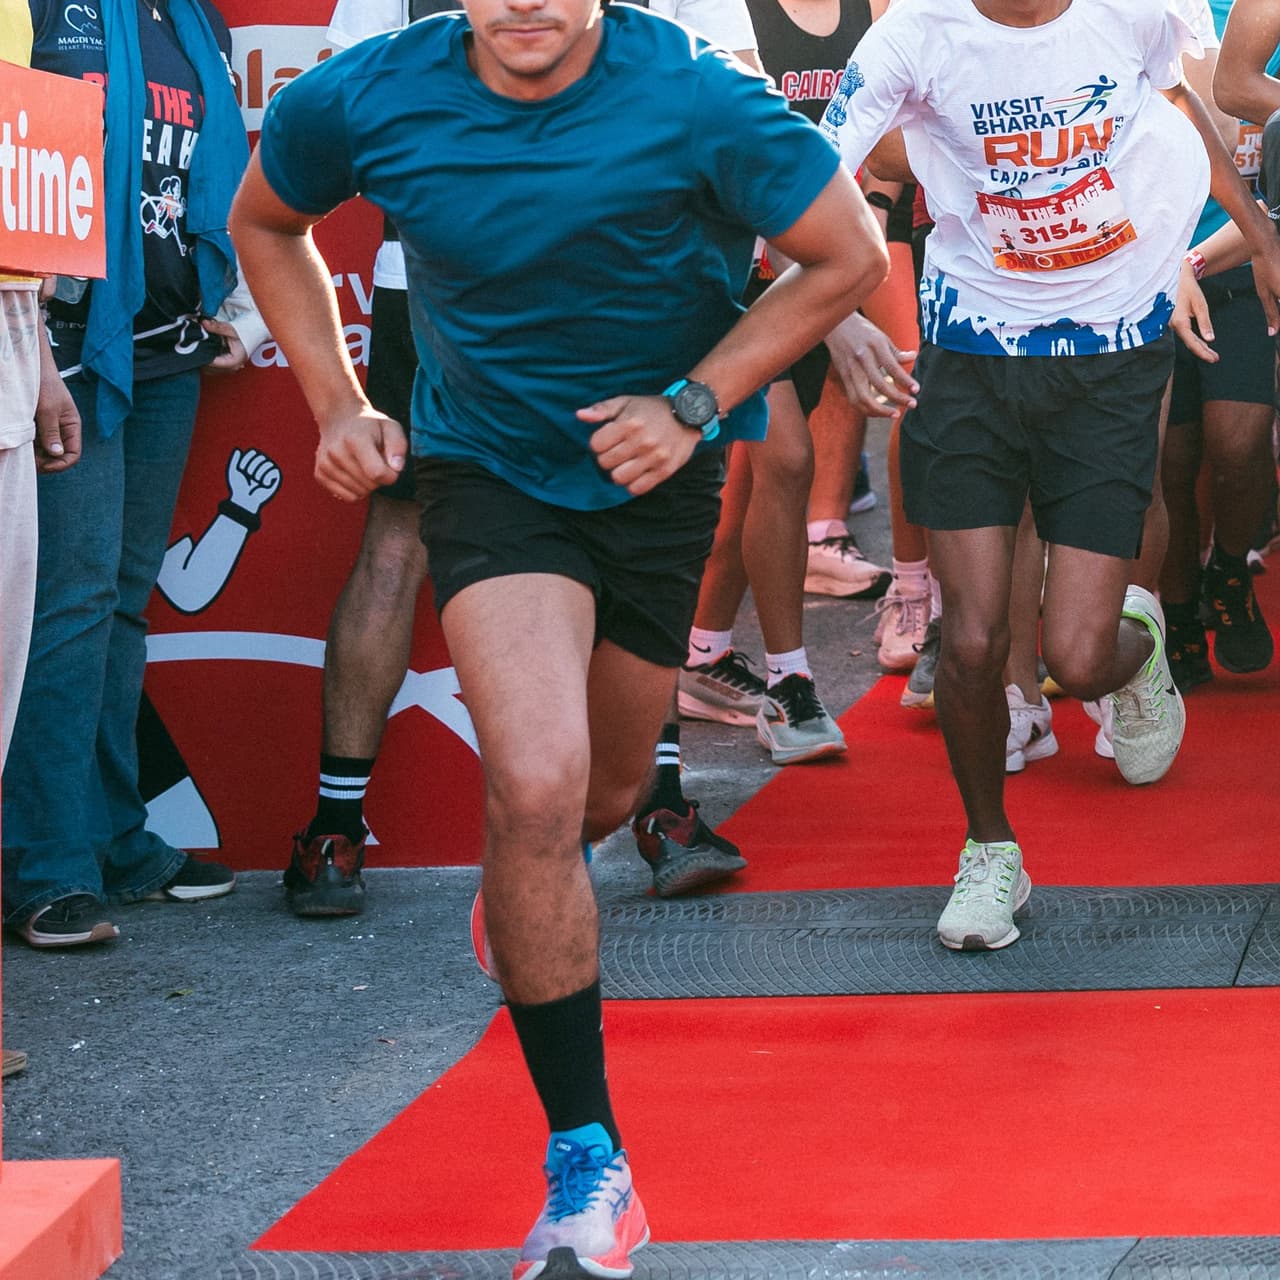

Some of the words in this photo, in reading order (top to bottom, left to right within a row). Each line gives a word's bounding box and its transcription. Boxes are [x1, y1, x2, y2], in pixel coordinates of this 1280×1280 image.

[147, 81, 194, 128] THE
[971, 96, 1044, 119] VIKSIT
[973, 110, 1068, 135] BHARAT
[984, 117, 1114, 167] RUN
[986, 203, 1018, 221] RUN
[1023, 205, 1059, 221] THE
[1061, 180, 1106, 213] RACE
[1020, 217, 1088, 244] 3154
